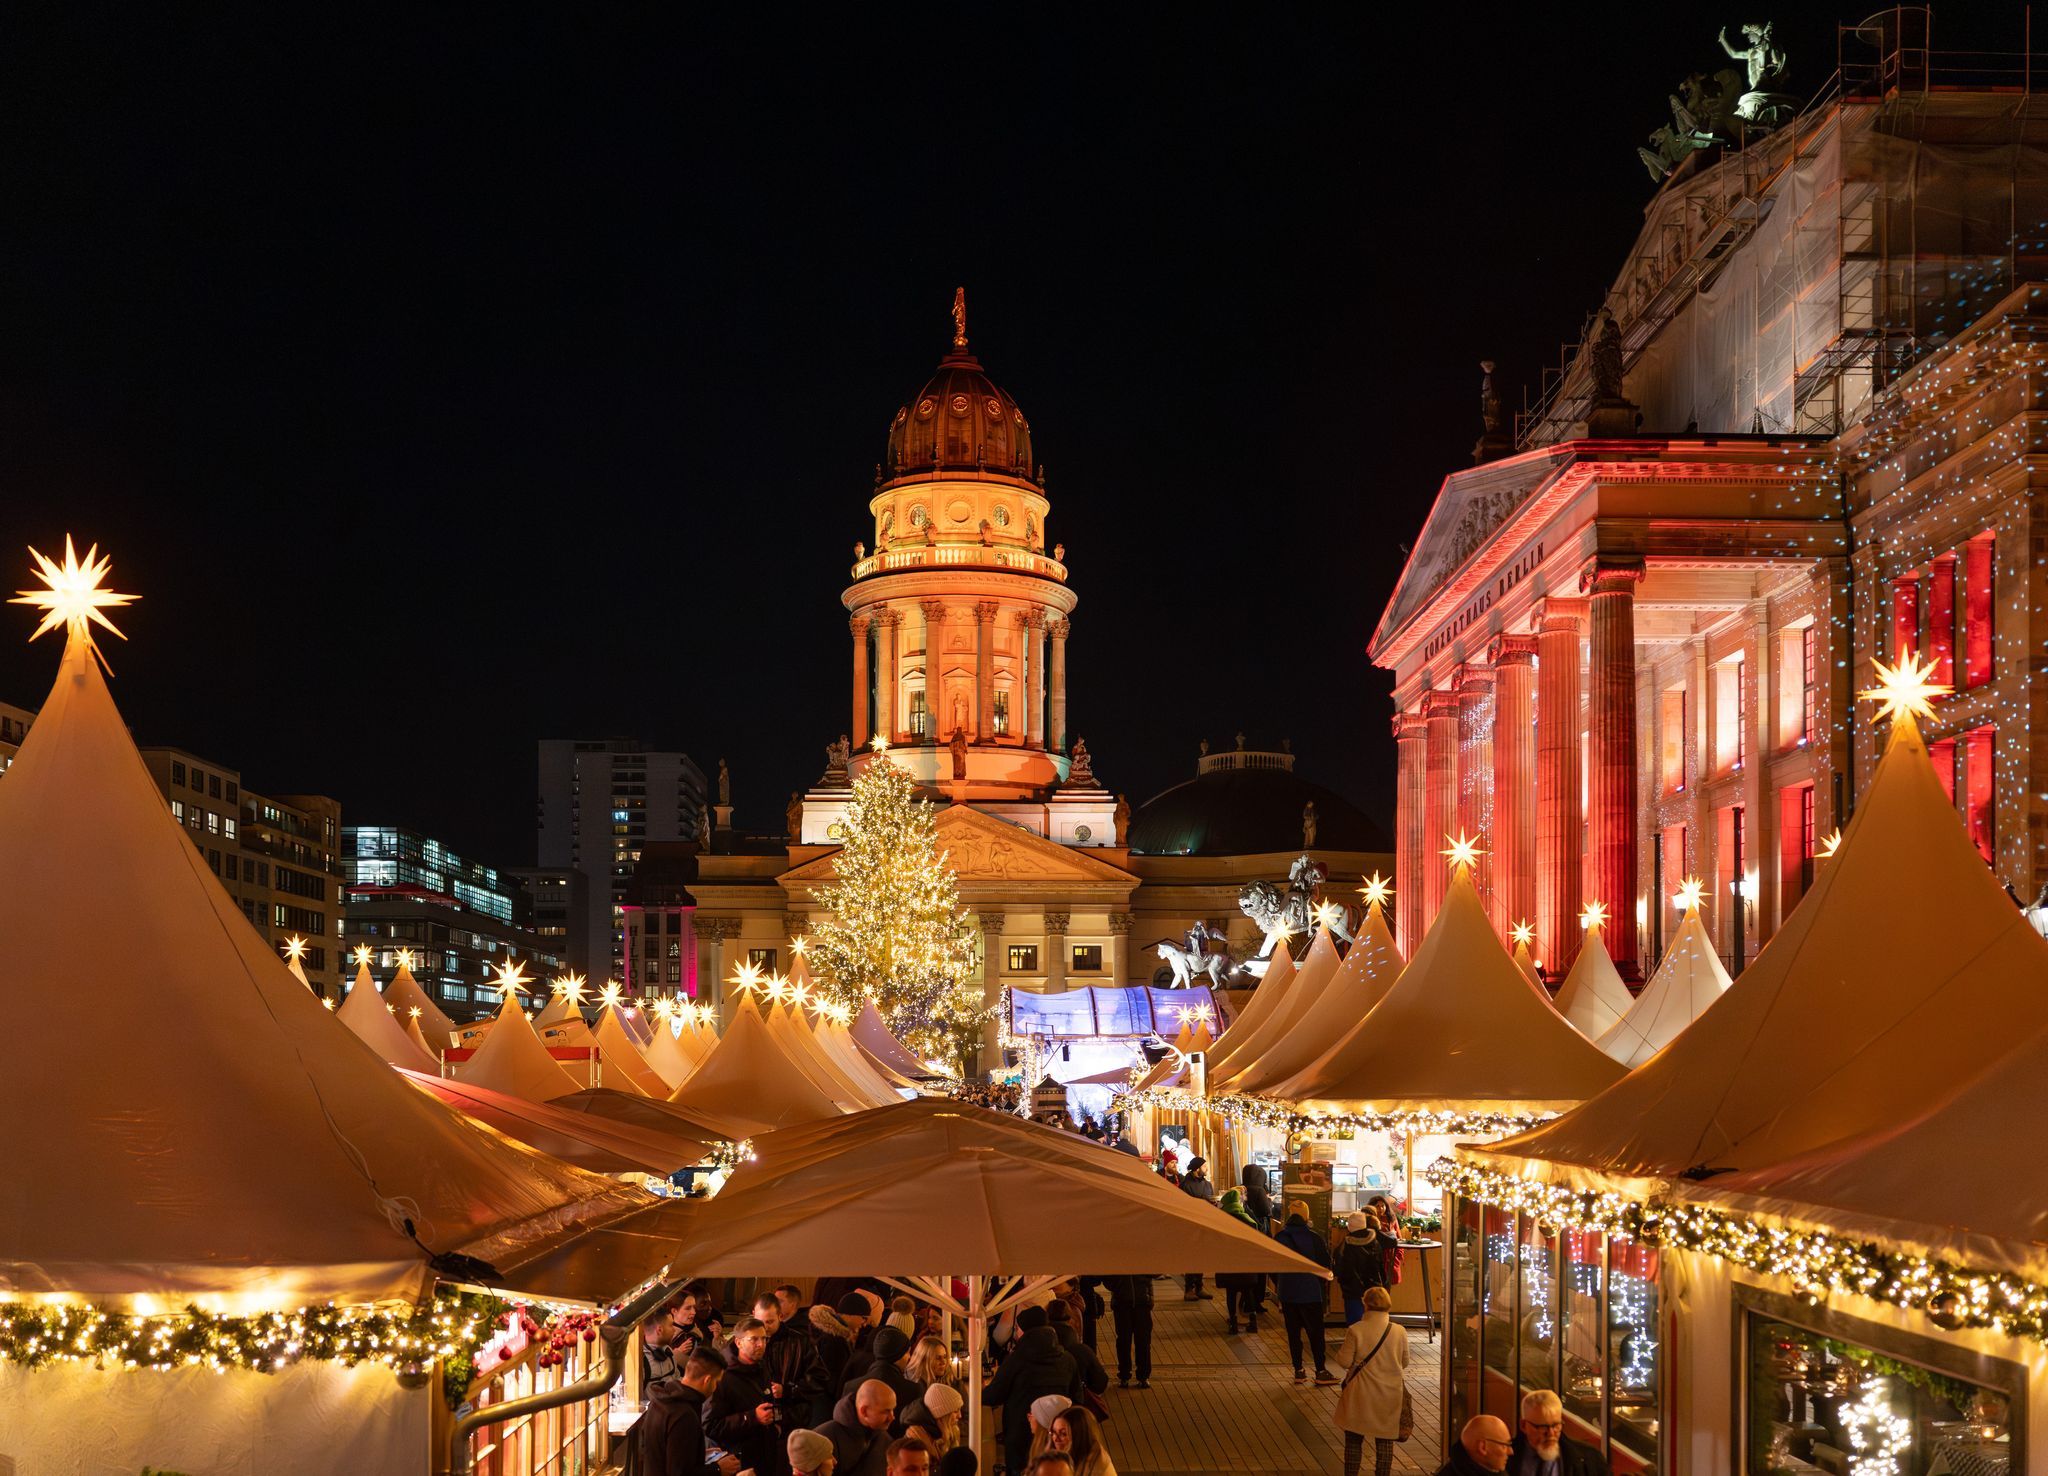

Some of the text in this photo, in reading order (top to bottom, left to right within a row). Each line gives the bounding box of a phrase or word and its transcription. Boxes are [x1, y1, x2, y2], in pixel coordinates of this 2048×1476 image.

[1424, 542, 1544, 661] KONZERTHAUS BERLIN
[629, 926, 638, 989] HILTON
